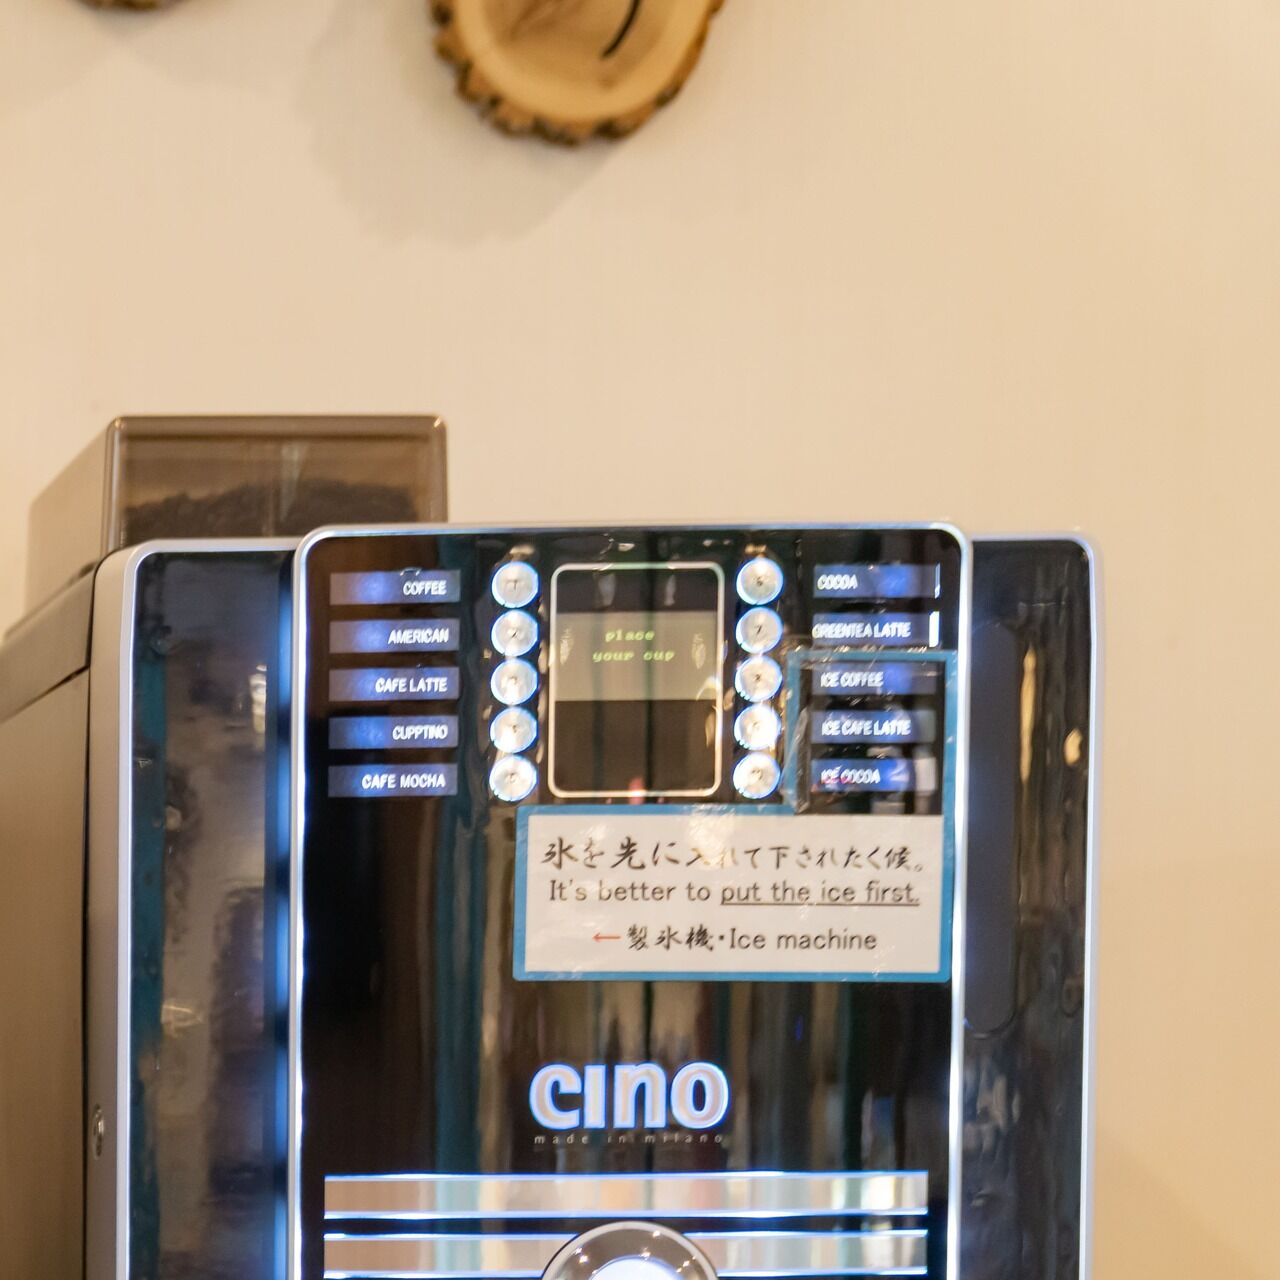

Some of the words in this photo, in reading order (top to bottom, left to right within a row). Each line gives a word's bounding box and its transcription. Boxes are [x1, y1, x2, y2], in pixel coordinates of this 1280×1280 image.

[403, 581, 447, 596] COFFEE
[817, 574, 858, 590] COCOA
[389, 630, 449, 644] AMERICAN
[605, 629, 655, 642] place
[873, 622, 912, 638] LATTE
[592, 651, 635, 662] your
[643, 651, 675, 662] cup
[375, 678, 406, 693] CAFE
[409, 677, 447, 692] LATTE
[820, 672, 840, 687] ICE
[840, 672, 884, 687] COFFEE
[821, 720, 841, 736] ICE
[873, 719, 911, 735] LATTE
[362, 774, 396, 789] CAFE
[400, 773, 446, 788] MOCHA
[840, 768, 881, 784] COCOA
[550, 880, 586, 901] It's
[599, 879, 675, 901] better
[686, 881, 711, 901] to
[721, 881, 761, 905] put
[772, 880, 809, 901] the
[820, 880, 855, 901] ice
[776, 929, 877, 949] machine
[530, 1061, 729, 1131] cino
